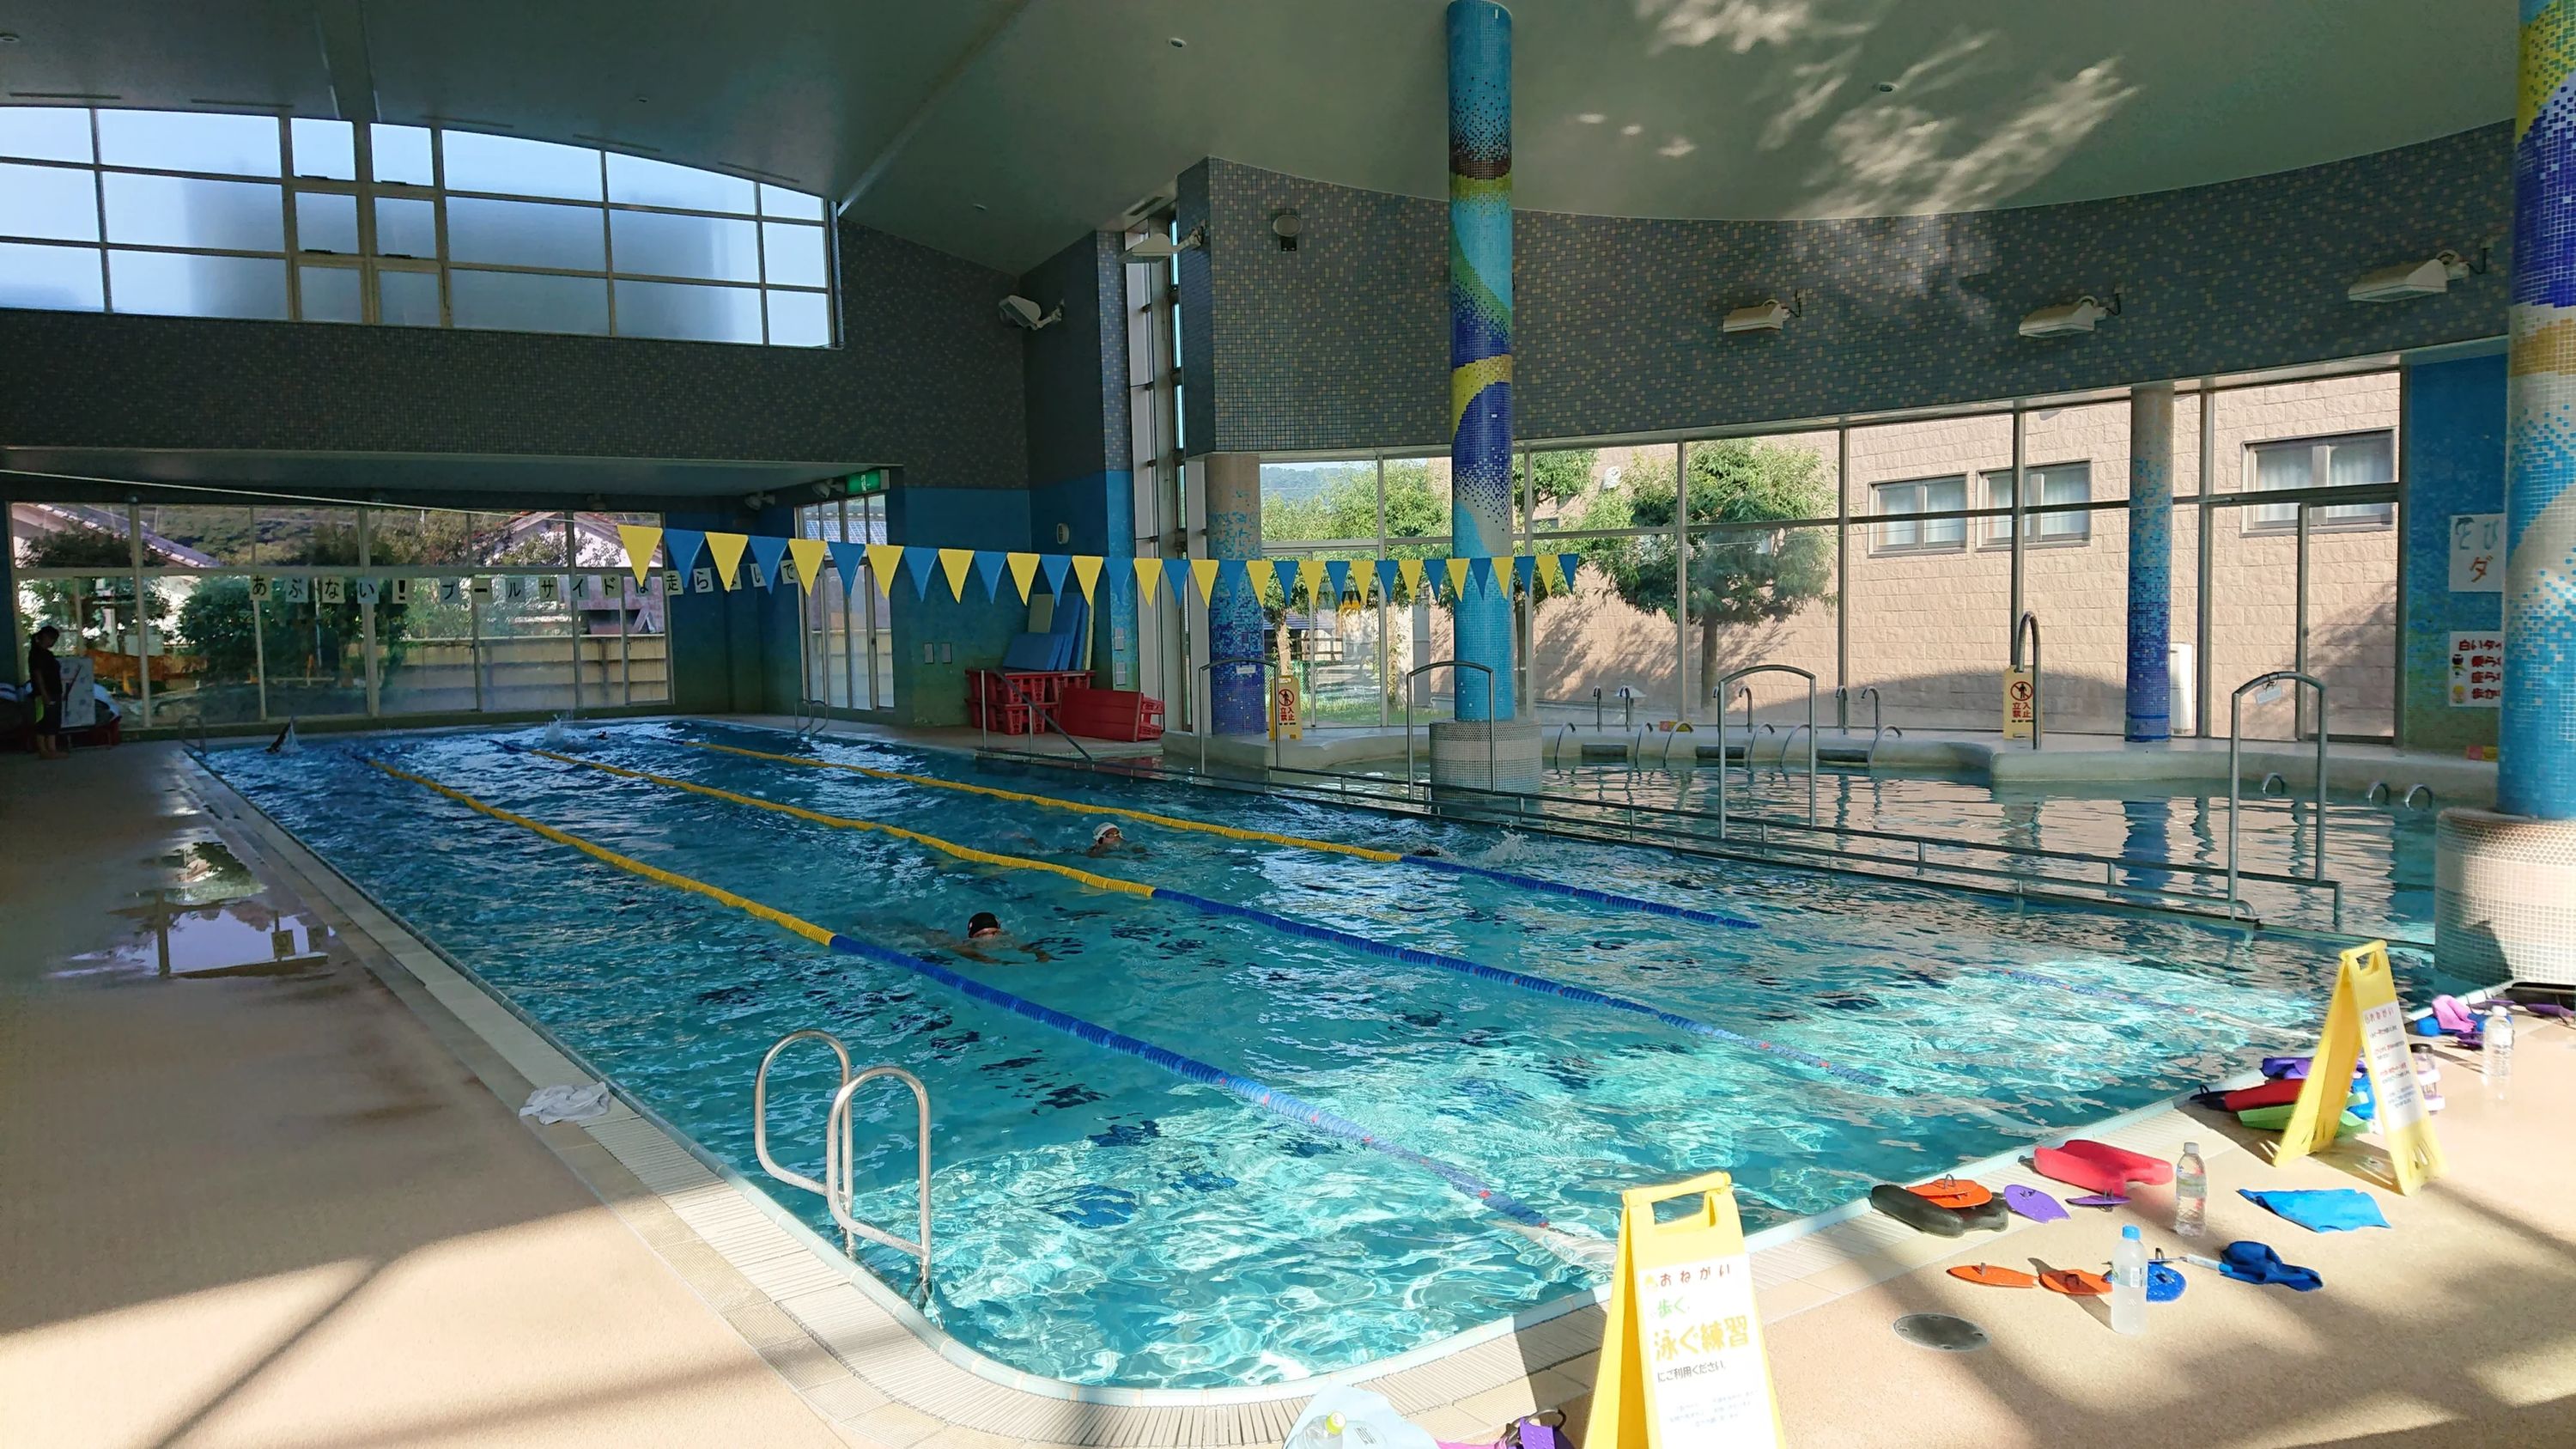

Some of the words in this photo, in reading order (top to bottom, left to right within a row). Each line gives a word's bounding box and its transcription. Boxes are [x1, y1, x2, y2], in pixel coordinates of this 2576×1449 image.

[1659, 1263, 1731, 1288] おねがい
[1653, 1314, 1750, 1362] 泳ぐ練習
